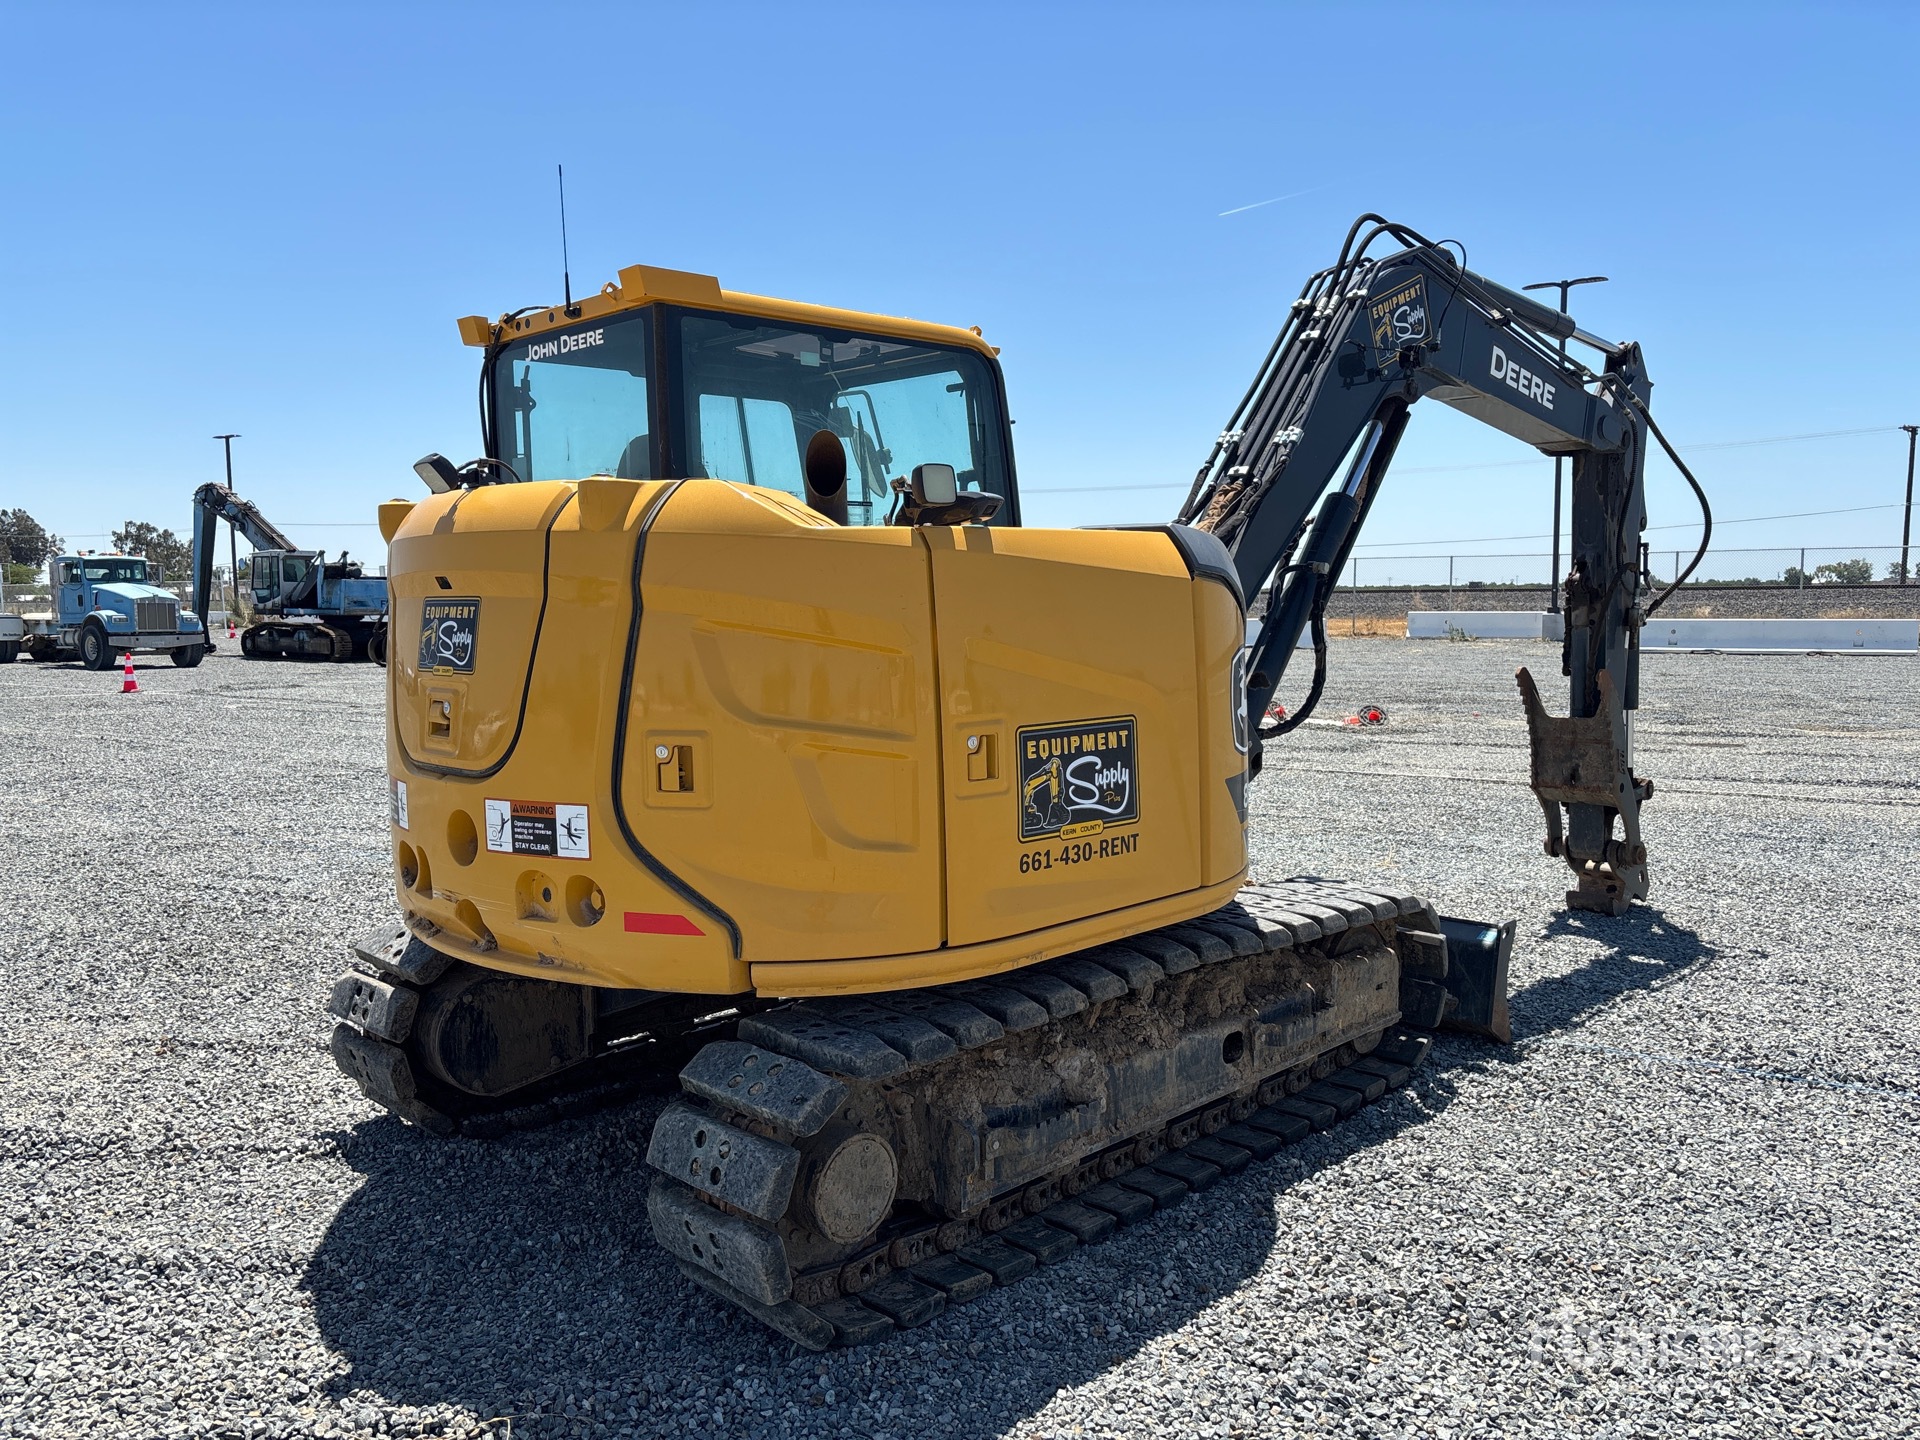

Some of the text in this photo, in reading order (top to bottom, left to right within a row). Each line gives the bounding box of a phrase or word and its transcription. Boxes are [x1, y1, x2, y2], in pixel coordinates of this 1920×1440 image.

[1372, 284, 1420, 319] EQUIPMENT
[1393, 304, 1426, 342] Supply
[525, 328, 604, 362] JOHN DEERE
[1489, 345, 1556, 411] DEERE
[425, 606, 476, 620] EQUIPMENT
[437, 620, 473, 666] Supply
[1026, 730, 1129, 760] EQUIPMENT
[1065, 755, 1130, 815] Supply
[513, 820, 534, 828] Operator
[518, 804, 554, 815] WARNING
[514, 841, 550, 851] STAY CLEAR
[1062, 824, 1101, 836] KERN COUNTY
[1019, 833, 1140, 874] 661-430-RENT
